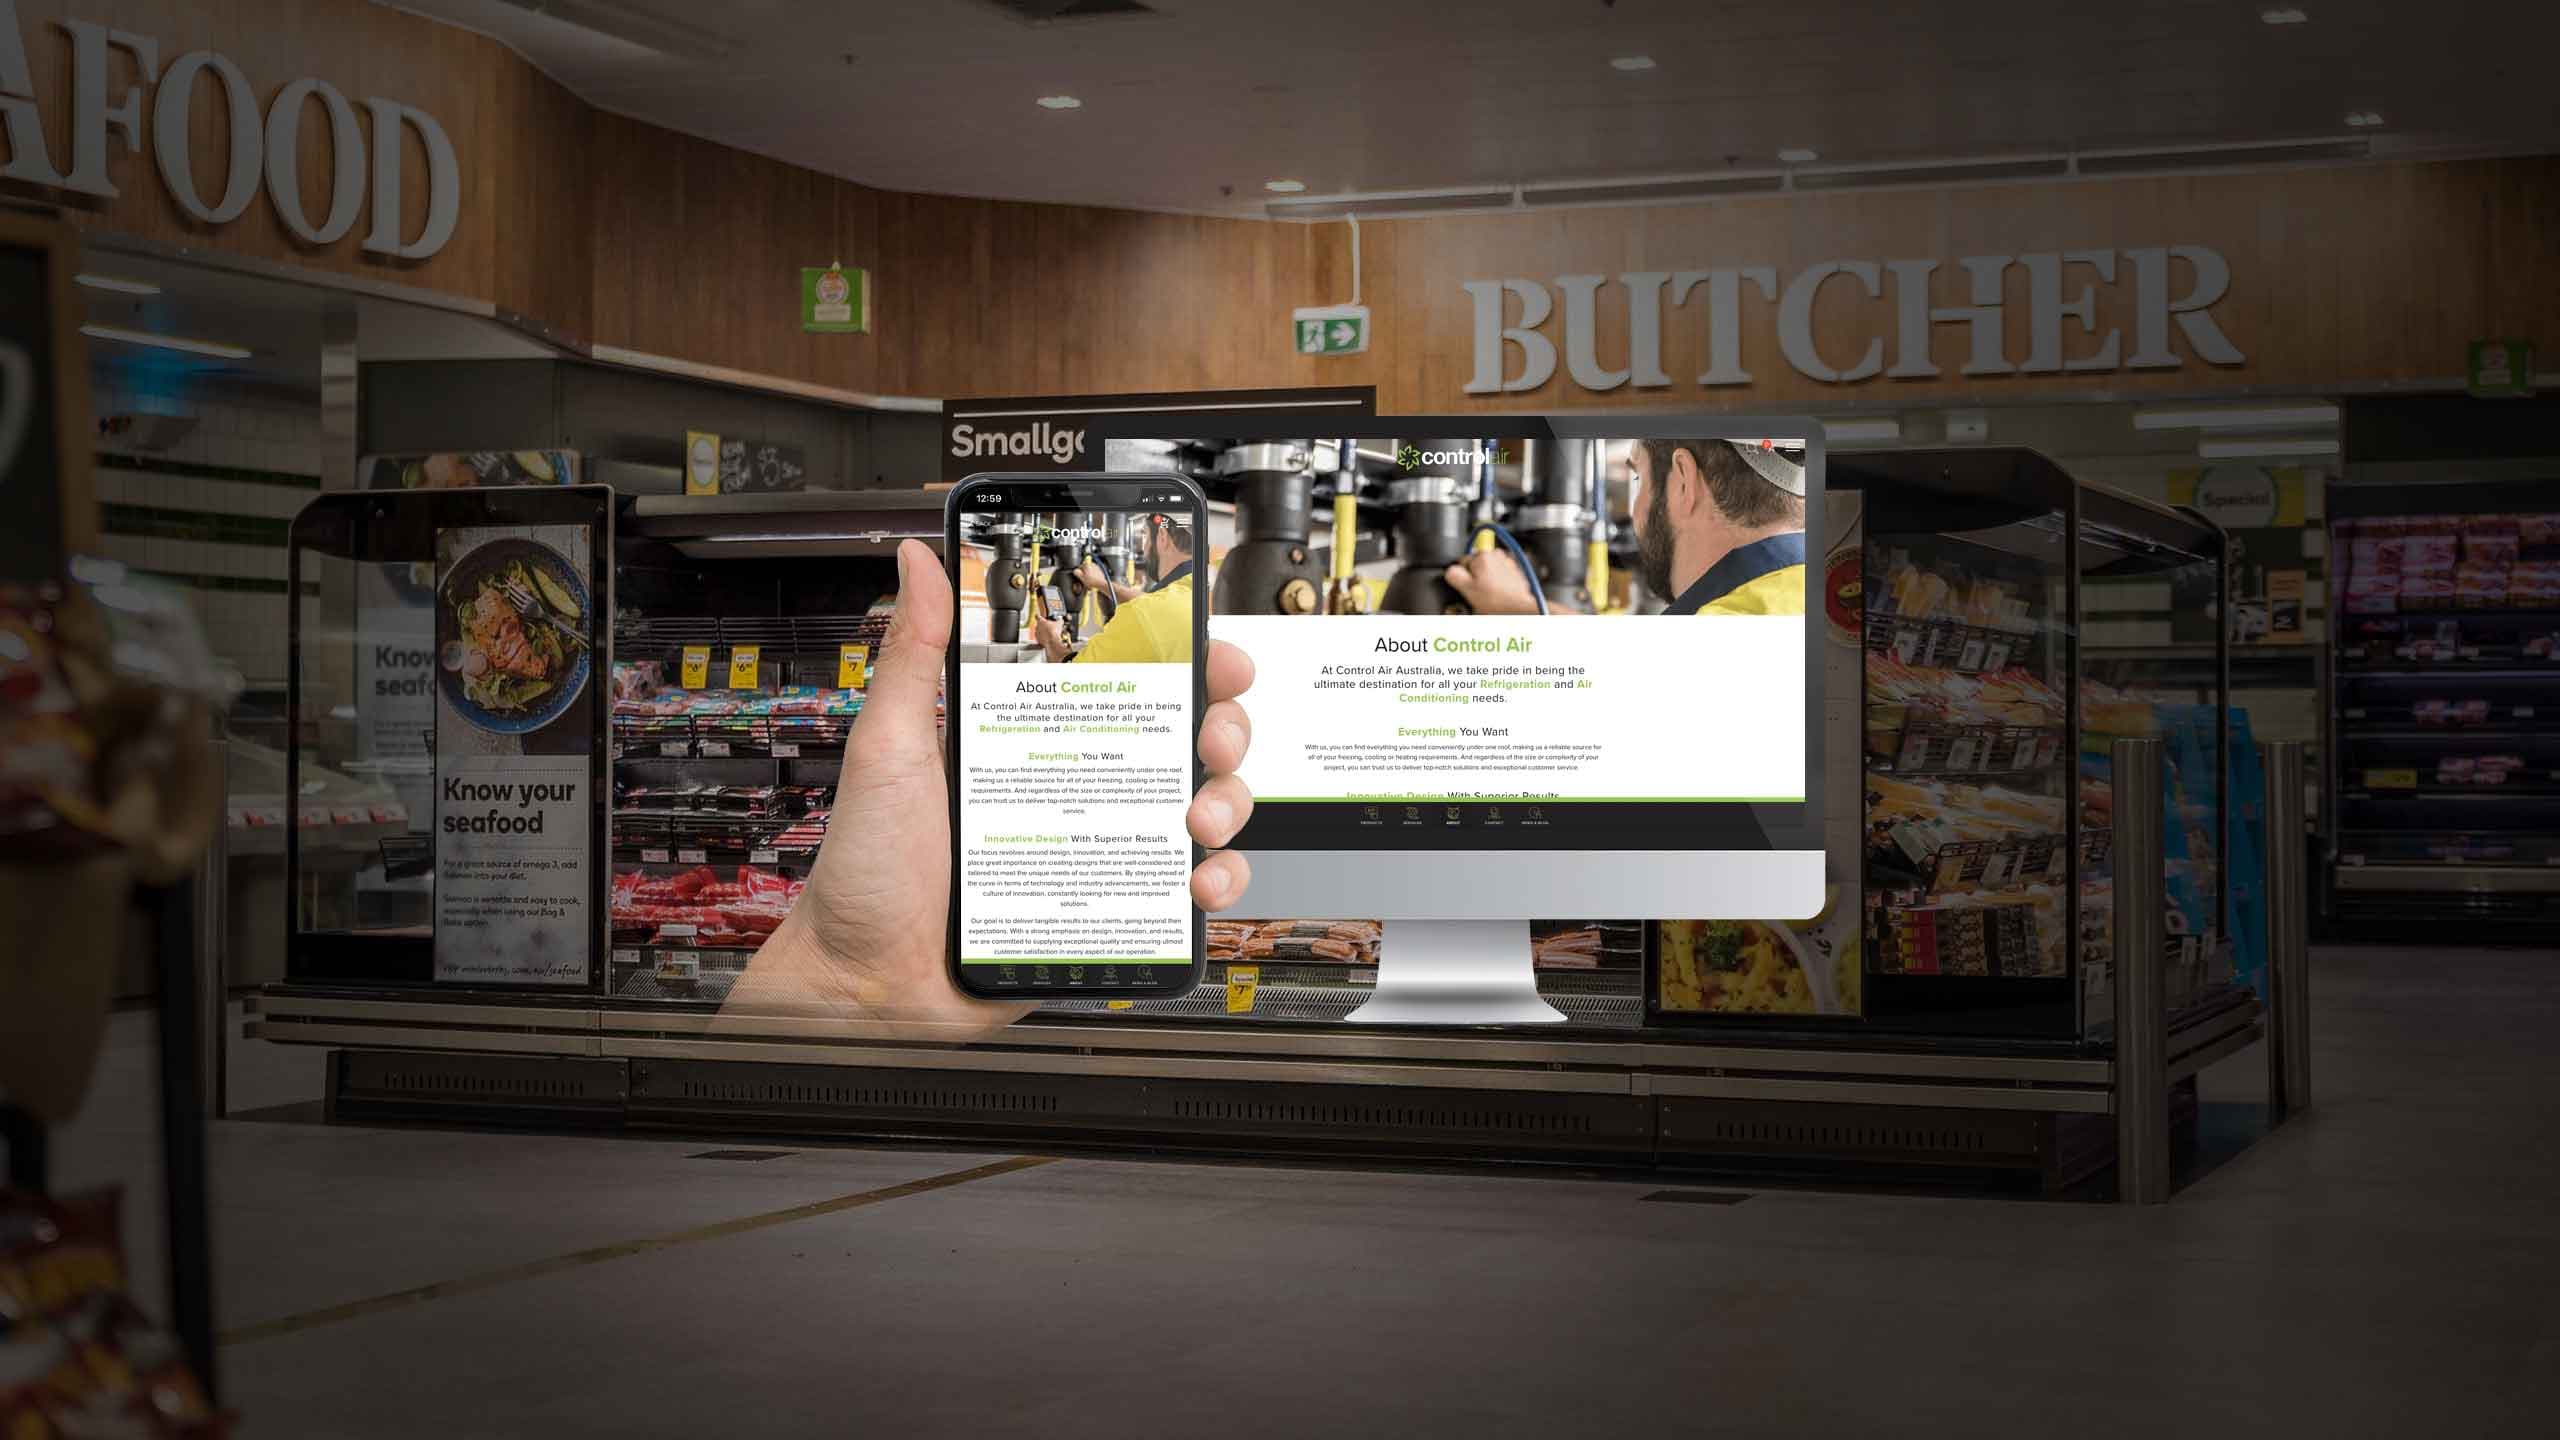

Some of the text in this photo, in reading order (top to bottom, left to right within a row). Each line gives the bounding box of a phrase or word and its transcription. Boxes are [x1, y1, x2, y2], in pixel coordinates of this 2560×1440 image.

[1461, 245, 2247, 395] BUTCHER
[976, 494, 1002, 503] 12:59
[1374, 636, 1532, 653] About Control Air
[1321, 665, 1585, 677] At Control Air Australia, we take pride in being the
[1015, 681, 1137, 693] About Control Air
[1313, 679, 1592, 691] ultimate destination for all your Refrigeration and Air
[1399, 691, 1509, 705] Conditioning needs.
[970, 702, 981, 710] At
[983, 702, 1017, 710] Control
[1019, 702, 1032, 710] Air
[1035, 702, 1078, 711] Australia,
[1096, 702, 1116, 710] take
[1118, 702, 1142, 712] pride
[1144, 702, 1153, 710] in
[1155, 702, 1182, 712] being
[996, 714, 1155, 724] the ultimate destination for all your
[978, 725, 1173, 735] Refrigeration and Air Conditioning needs.
[1397, 727, 1509, 738] Everything You Want
[1028, 752, 1124, 762] Everything You Want
[444, 778, 576, 808] Know your
[1447, 791, 1471, 799] With
[443, 809, 544, 834] seafood
[984, 834, 1168, 844] Innovative Design With Superior Results
